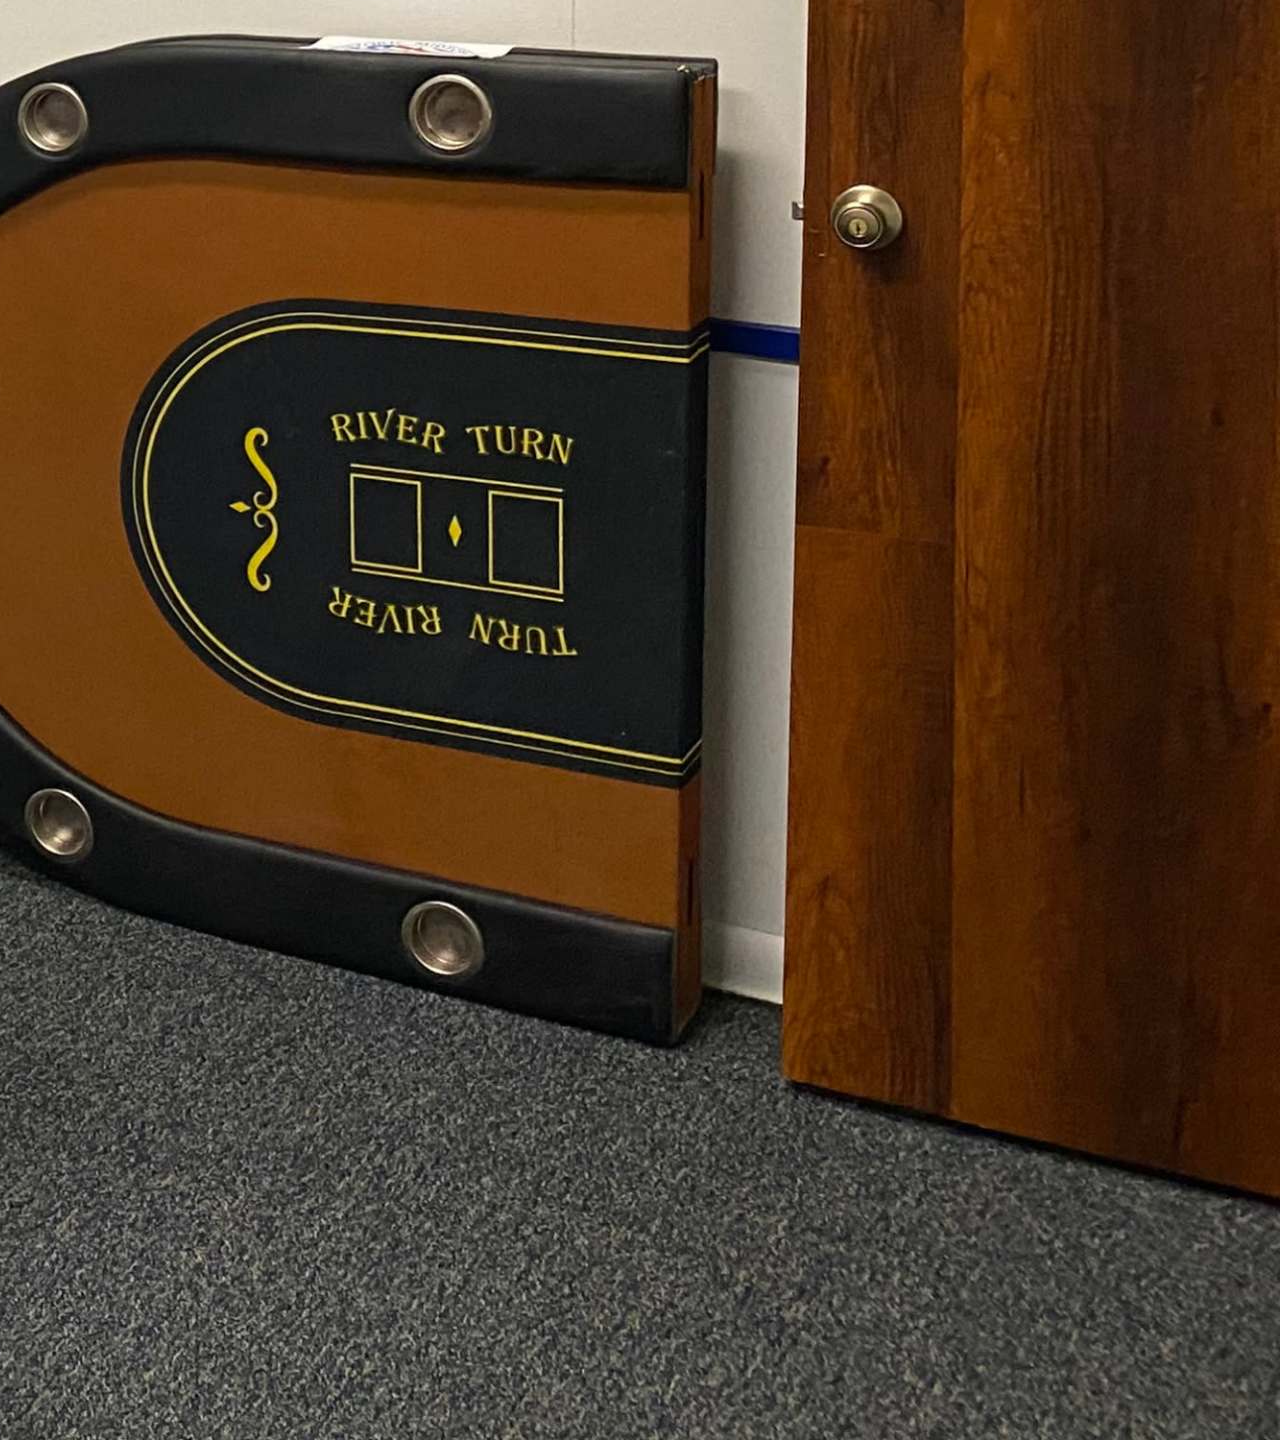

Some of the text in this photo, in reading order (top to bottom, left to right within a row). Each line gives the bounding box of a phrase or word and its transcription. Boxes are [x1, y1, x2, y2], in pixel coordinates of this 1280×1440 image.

[330, 407, 575, 466] RIVER TURN
[328, 586, 579, 657] TURN RIVER
